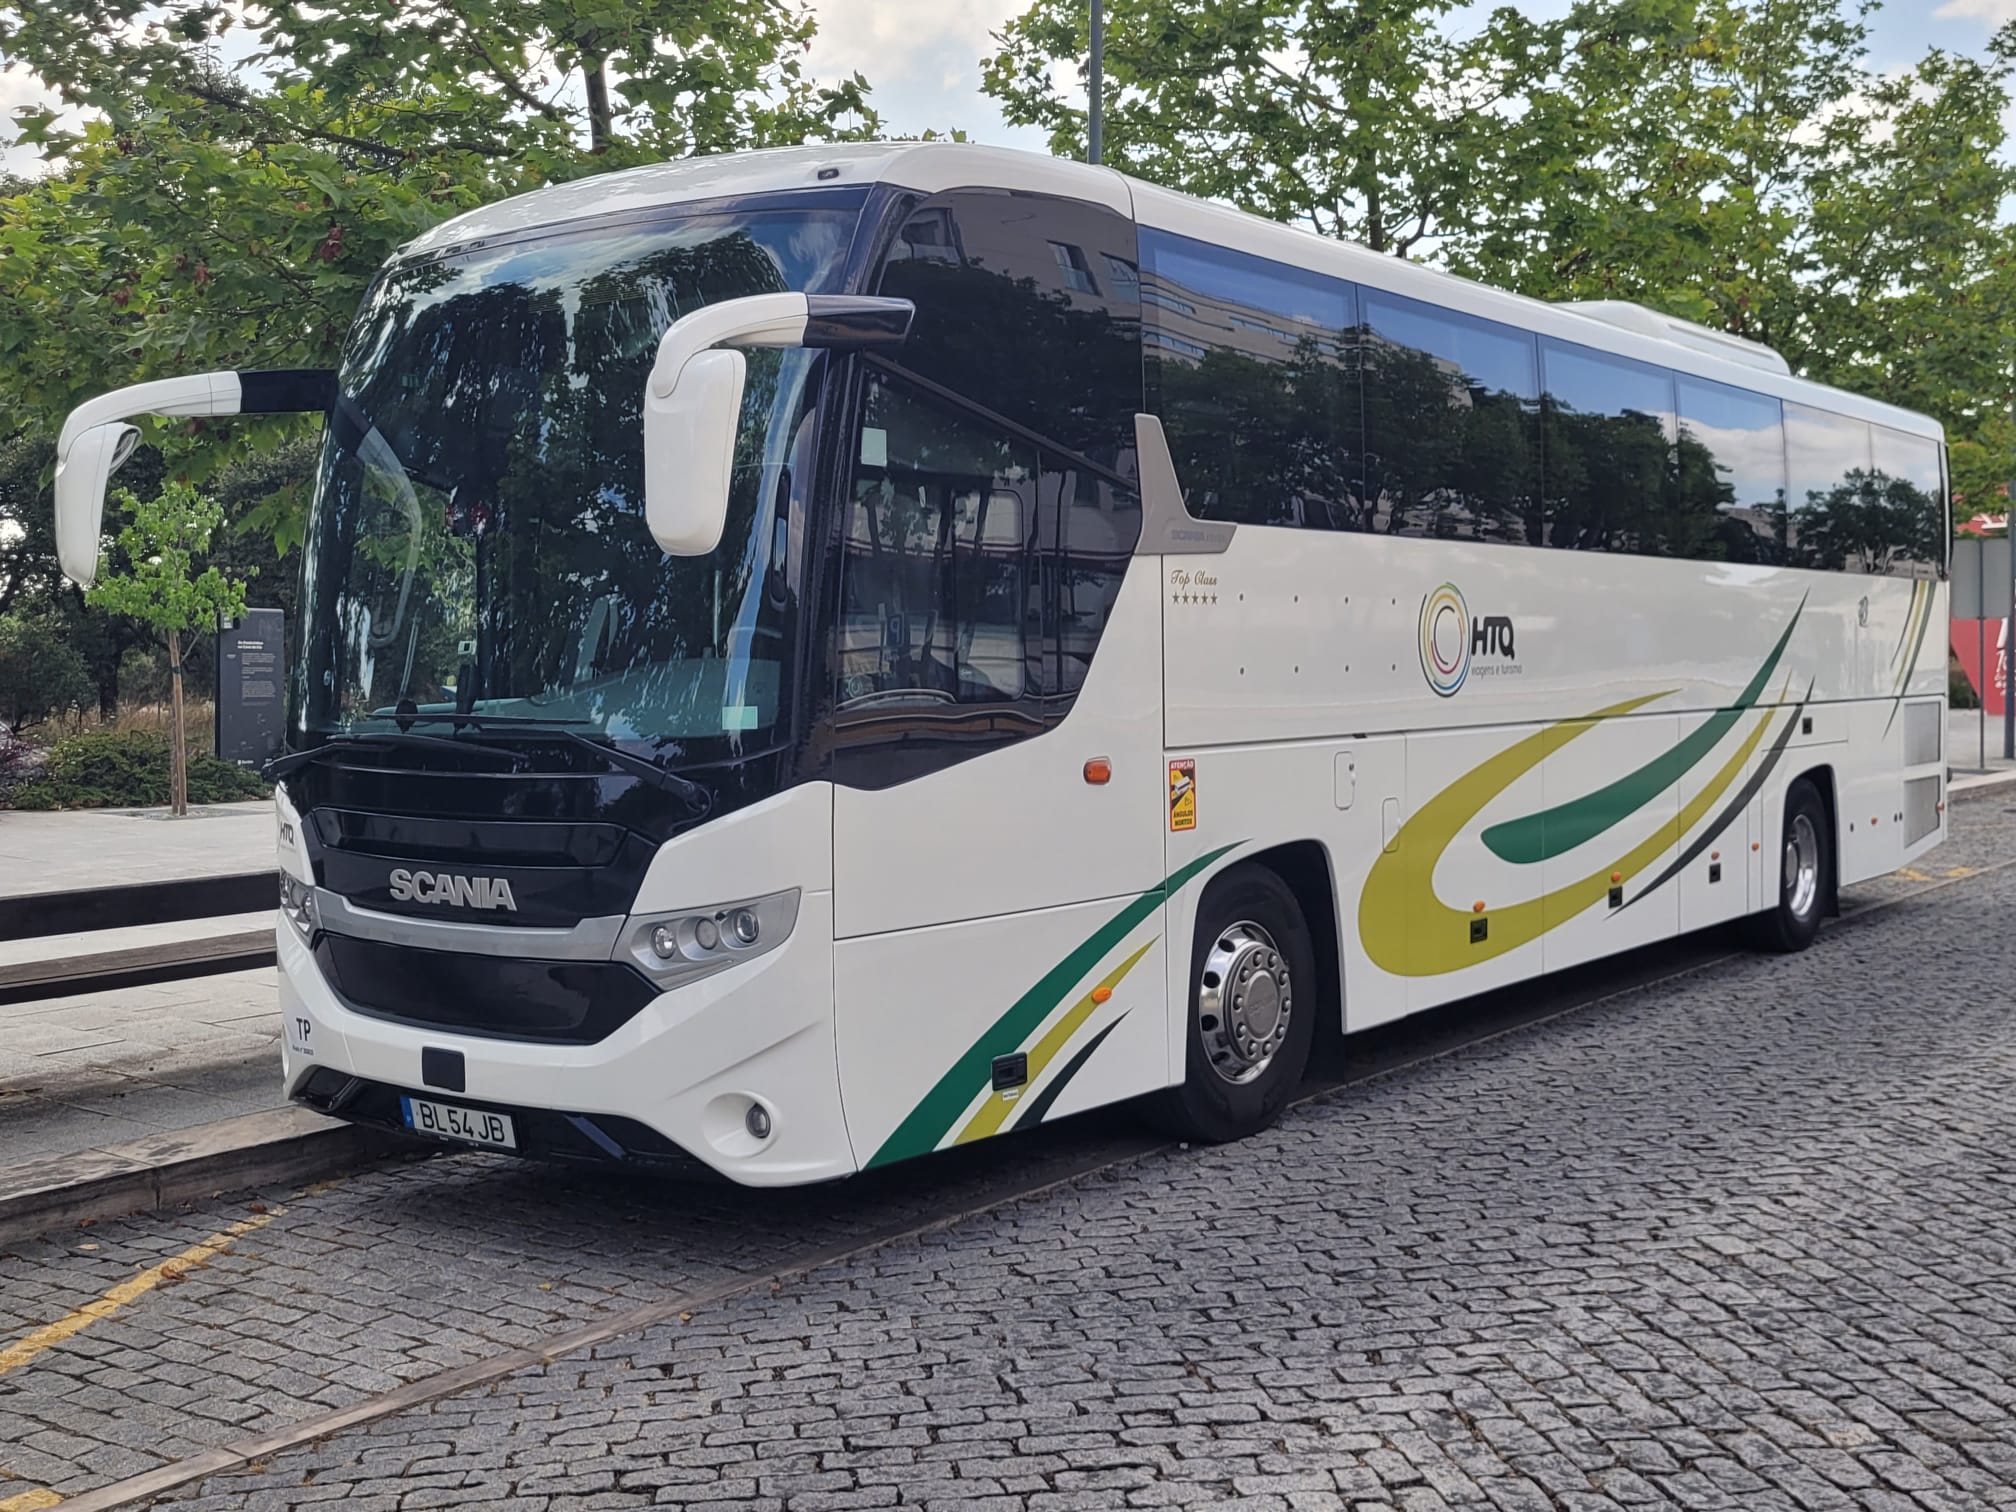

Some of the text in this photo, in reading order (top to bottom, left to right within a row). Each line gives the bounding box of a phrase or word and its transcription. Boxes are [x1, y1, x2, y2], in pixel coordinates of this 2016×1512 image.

[1170, 569, 1218, 590] Top Class
[1471, 615, 1515, 660] HTQ
[1471, 665, 1494, 679] viagens
[1501, 664, 1523, 675] turismo
[389, 868, 518, 912] SCANIA
[295, 1017, 312, 1042] TP
[418, 1102, 505, 1143] BL 54 JB
